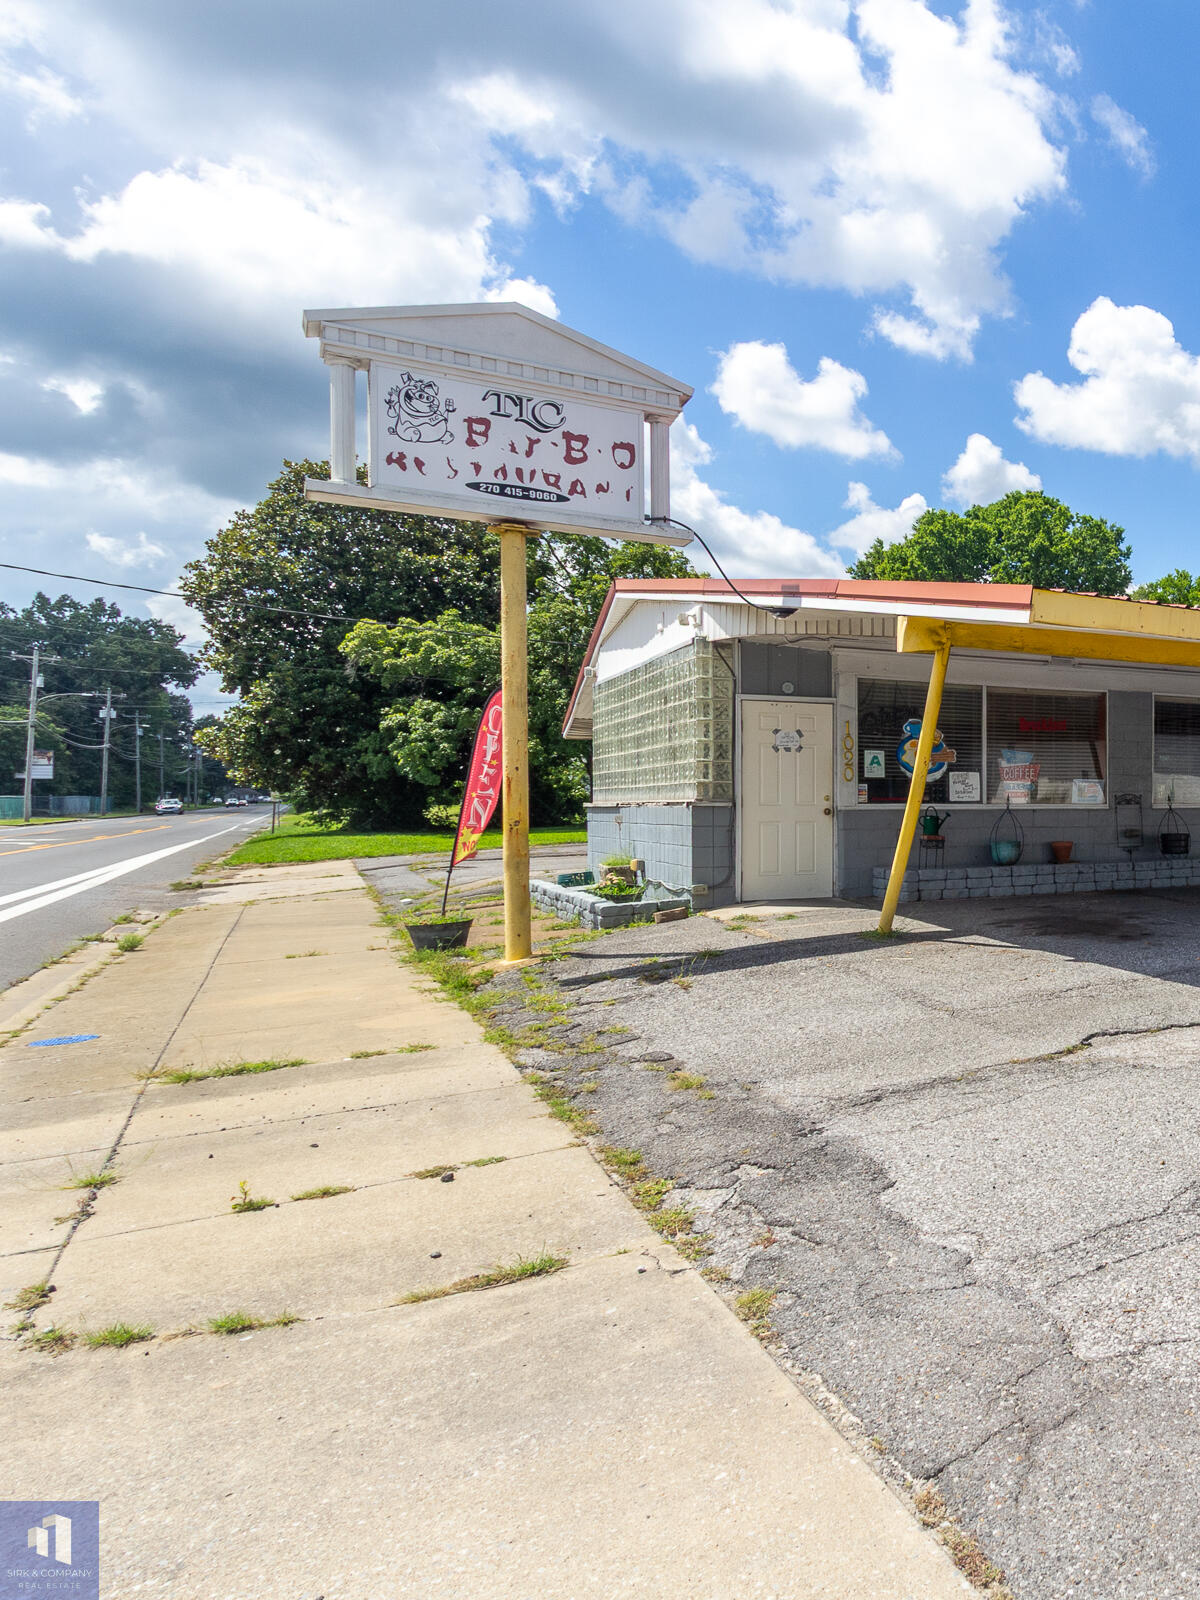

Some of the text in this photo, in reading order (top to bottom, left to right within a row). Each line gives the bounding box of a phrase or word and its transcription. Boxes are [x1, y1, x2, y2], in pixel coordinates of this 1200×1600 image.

[482, 389, 567, 433] TLC
[429, 414, 440, 423] TLC
[479, 482, 557, 502] 270 415-9060
[842, 719, 854, 783] 1020
[869, 755, 881, 766] A
[1004, 768, 1035, 780] COFFEE
[462, 840, 478, 852] NO
